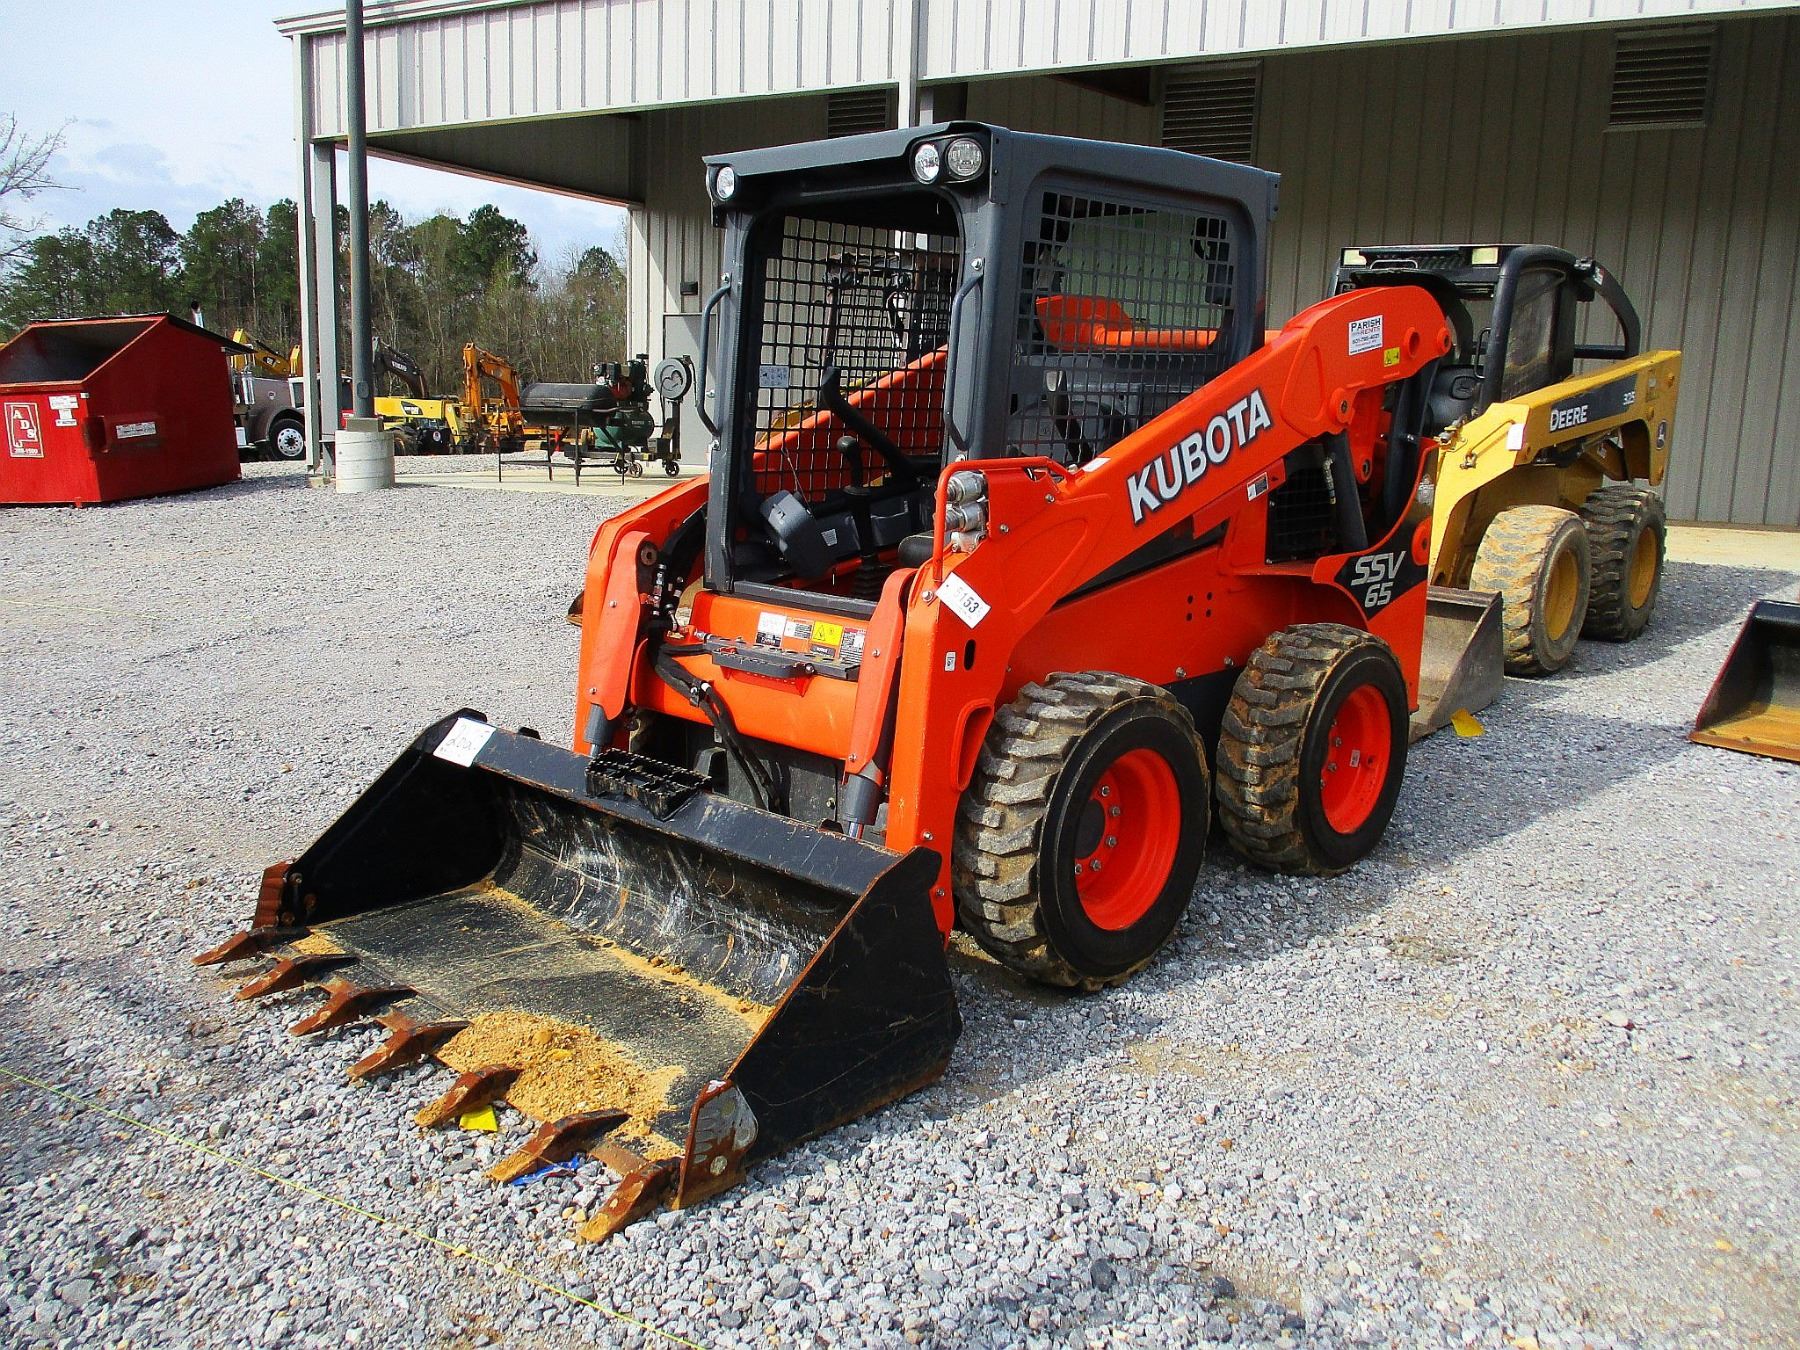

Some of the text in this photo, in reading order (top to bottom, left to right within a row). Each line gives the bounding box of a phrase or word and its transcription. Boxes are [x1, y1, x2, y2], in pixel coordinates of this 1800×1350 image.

[1351, 318, 1381, 331] PARISH
[1550, 404, 1588, 432] DEERE
[1127, 389, 1271, 523] KUBOTA
[1351, 551, 1407, 586] SSV
[1365, 582, 1394, 607] 65
